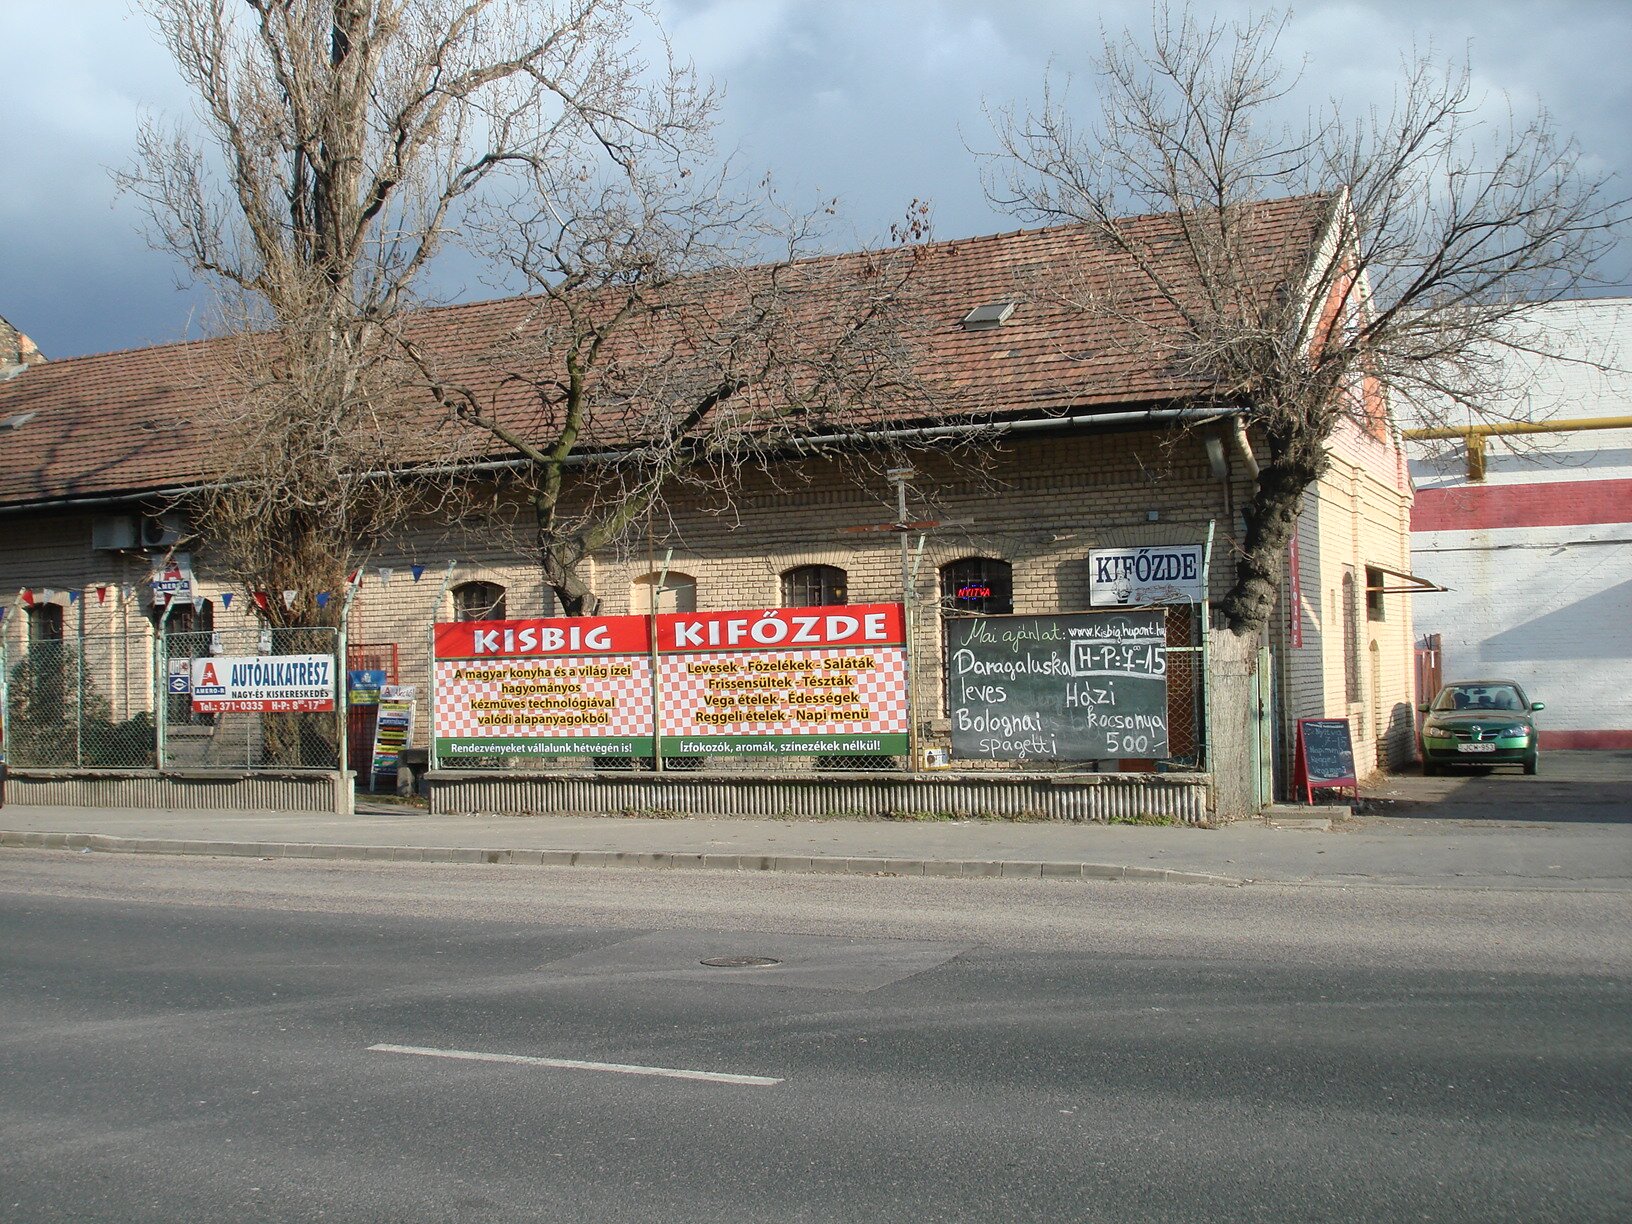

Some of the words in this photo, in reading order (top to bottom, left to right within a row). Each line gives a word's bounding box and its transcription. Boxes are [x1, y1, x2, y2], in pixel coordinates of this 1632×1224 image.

[1096, 549, 1197, 583] KIFŐZDE
[958, 588, 991, 597] NYITVA
[674, 610, 888, 648] KIFŐZDE
[961, 618, 997, 646] Mai
[474, 625, 612, 654] KISBIG
[231, 657, 329, 687] AUTÓALKATRÉSZ
[687, 662, 738, 674] Levesek
[748, 660, 814, 672] Főzelékek
[824, 657, 875, 669] Saláták
[953, 648, 1072, 681] Daragaluska
[454, 671, 462, 679] A
[465, 670, 507, 681] magyar
[509, 667, 551, 680] konyha
[554, 667, 566, 677] és
[569, 668, 576, 677] a
[578, 666, 608, 678] világ
[610, 665, 632, 676] ízei
[501, 683, 581, 695] hagyományos
[708, 676, 792, 690] Frissensültek
[802, 676, 853, 687] Tészták
[961, 676, 1007, 704] leves
[266, 689, 329, 699] KISKERESKEDÉS
[704, 695, 735, 707] Vega
[738, 693, 777, 705] ételek
[788, 691, 860, 704] Édességek
[1066, 680, 1116, 708] Házi
[200, 703, 217, 711] Tel.:
[219, 701, 264, 711] 371-0335
[271, 701, 290, 711] H-P:
[471, 699, 526, 710] kézműves
[528, 697, 616, 711] technológiával
[478, 715, 512, 725] valódi
[514, 713, 609, 727] alapanyagokból
[696, 711, 743, 724] Reggeli
[745, 710, 785, 721] ételek
[796, 709, 827, 722] Napi
[830, 708, 869, 719] menü
[956, 707, 1041, 737] Bolognai
[1086, 705, 1167, 738] kocsonya
[451, 743, 526, 754] Rendezvényeket
[527, 743, 572, 753] vállalunk
[573, 743, 619, 755] hétvégén
[621, 743, 633, 753] is!
[680, 741, 734, 753] Ízfokozók,
[735, 741, 778, 752] aromák,
[780, 740, 840, 752] színezékek
[842, 739, 881, 751] nélkül!
[979, 733, 1057, 759] spagetti
